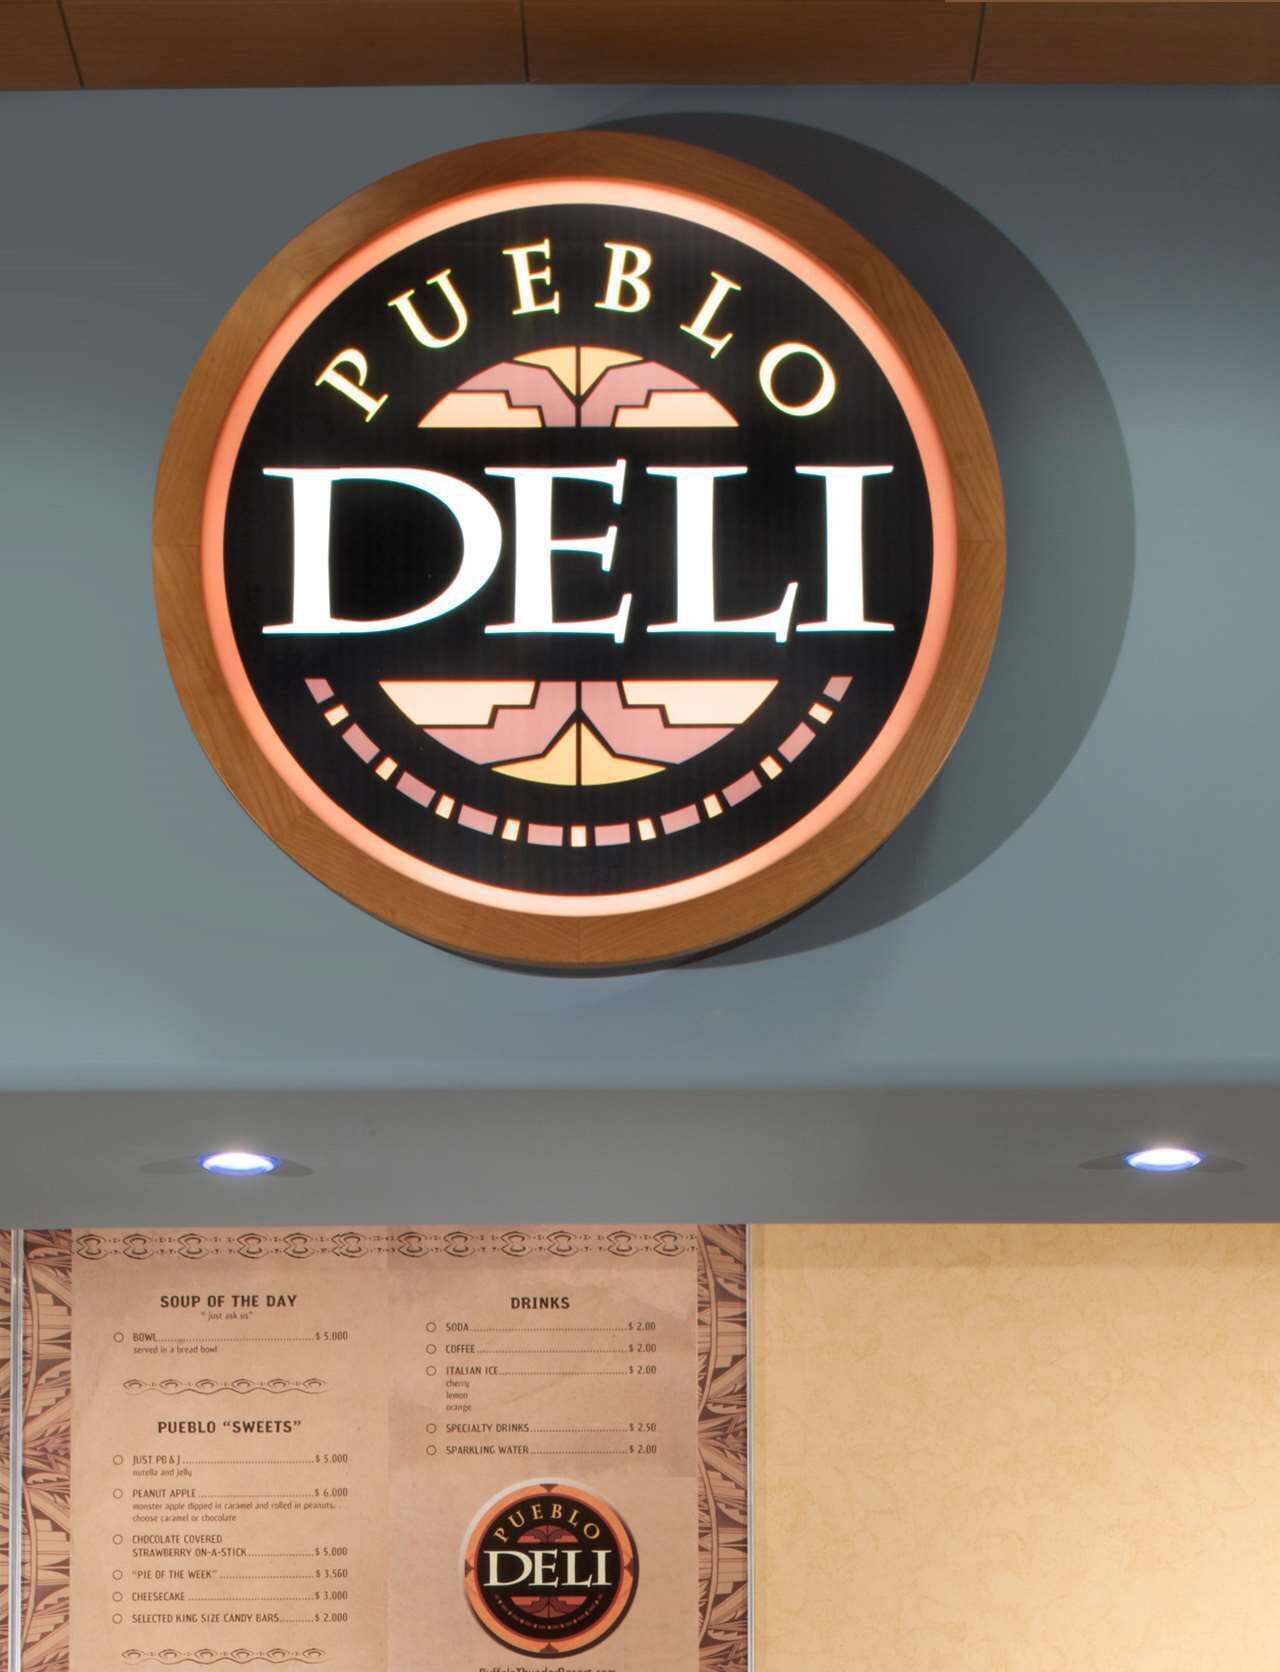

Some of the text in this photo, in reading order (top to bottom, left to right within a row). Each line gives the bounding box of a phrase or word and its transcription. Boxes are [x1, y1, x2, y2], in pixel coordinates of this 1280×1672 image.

[314, 239, 838, 421] PUEBLO
[262, 458, 895, 644] DELI
[160, 1294, 297, 1308] SOUP OF THE DAY
[510, 1296, 570, 1310] DRINKS
[445, 1322, 469, 1332] SODA
[132, 1332, 157, 1342] BOWL
[323, 1331, 348, 1341] 5.000
[445, 1344, 475, 1354] COFFEE
[637, 1343, 657, 1353] 2.00
[446, 1366, 498, 1376] ITALIAN ICE
[157, 1420, 216, 1434] PUEBLO
[445, 1423, 493, 1433] SPECIALTY
[496, 1423, 530, 1433] DRINKS
[637, 1422, 657, 1433] 2.50
[446, 1445, 496, 1455] SPARKLING
[498, 1445, 529, 1455] WATER
[637, 1444, 657, 1454] 2.00
[132, 1455, 181, 1466] JUST PB & J
[132, 1488, 196, 1498] PEANUT APPLE
[493, 1503, 601, 1543] PUEBLO
[132, 1534, 223, 1544] CHOCOLATE COVERED
[132, 1548, 192, 1558] STRAWBERRY
[194, 1547, 247, 1557] ON-A-STICK
[323, 1546, 348, 1557] 5.000
[483, 1548, 613, 1588] DELI
[154, 1569, 166, 1580] OF
[168, 1569, 184, 1579] THE
[132, 1591, 185, 1602] CHEESECAKE
[132, 1613, 280, 1624] SELECTED KING SIZE CANDY BARS
